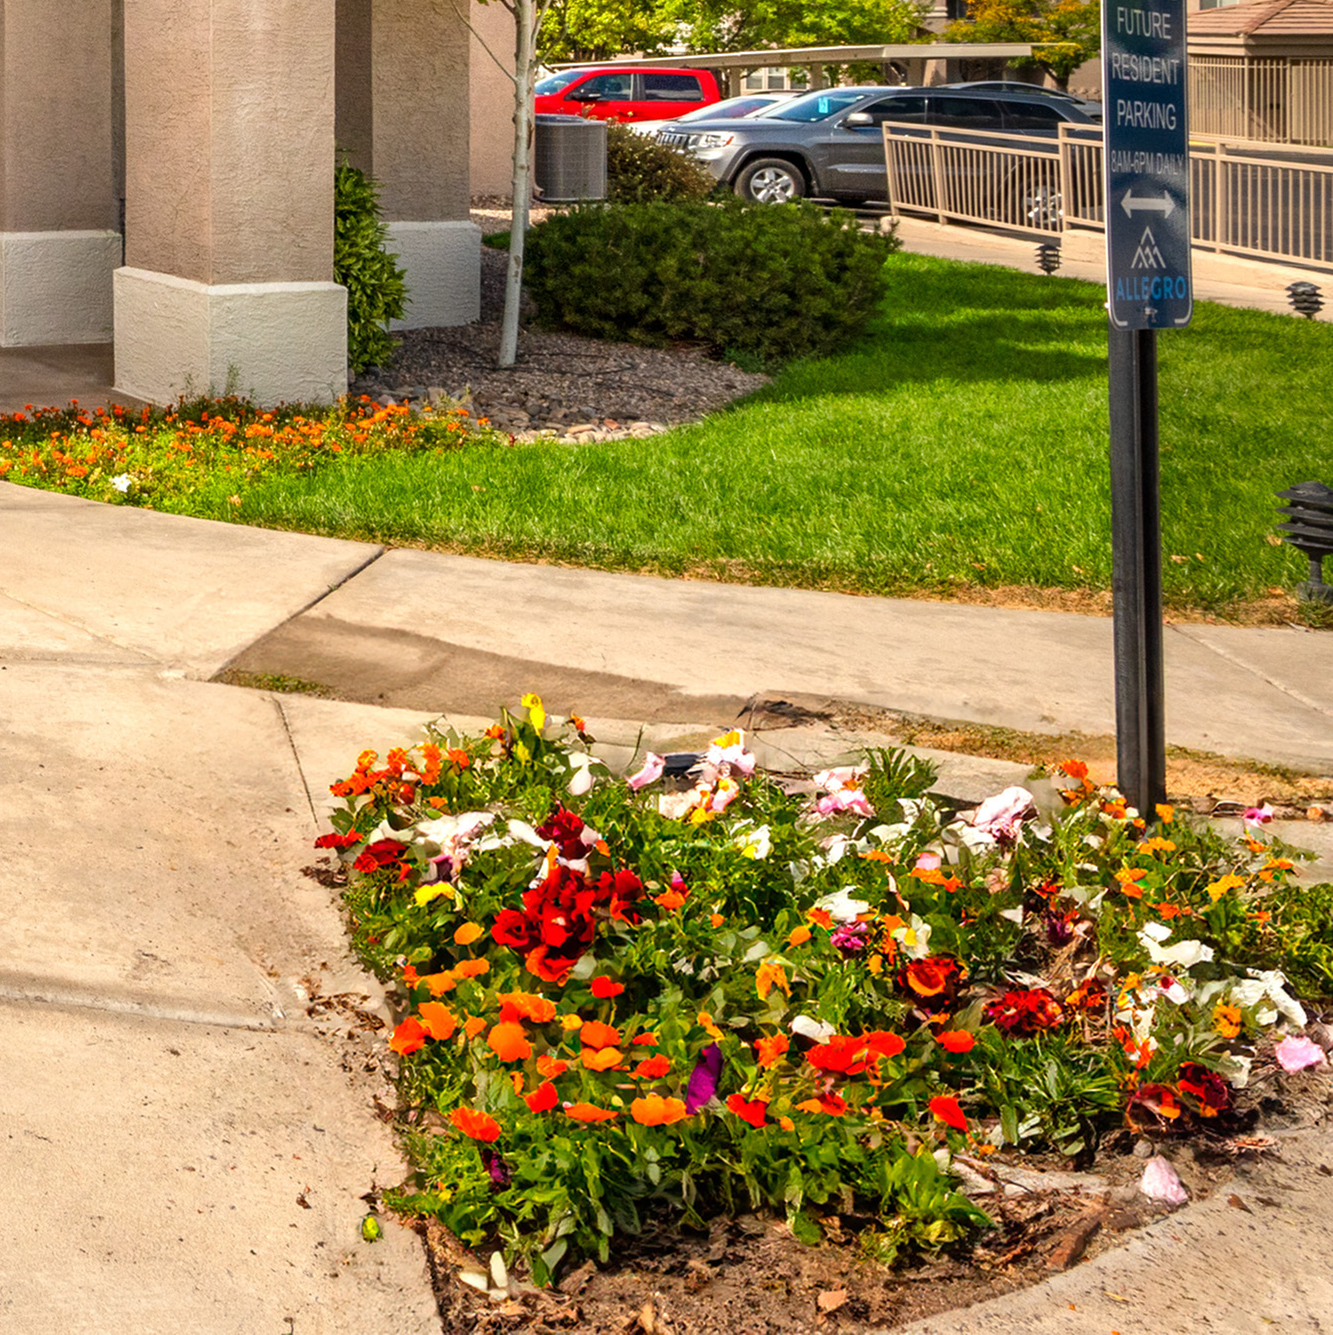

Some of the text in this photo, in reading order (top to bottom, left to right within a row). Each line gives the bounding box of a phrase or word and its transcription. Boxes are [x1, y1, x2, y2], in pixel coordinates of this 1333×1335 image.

[1117, 6, 1172, 40] FUTURE
[1111, 52, 1180, 85] RESIDENT
[1117, 99, 1177, 130] PARKING
[1110, 149, 1185, 175] 8AM-6PM DAILY
[1116, 275, 1187, 301] ALLEGRO
